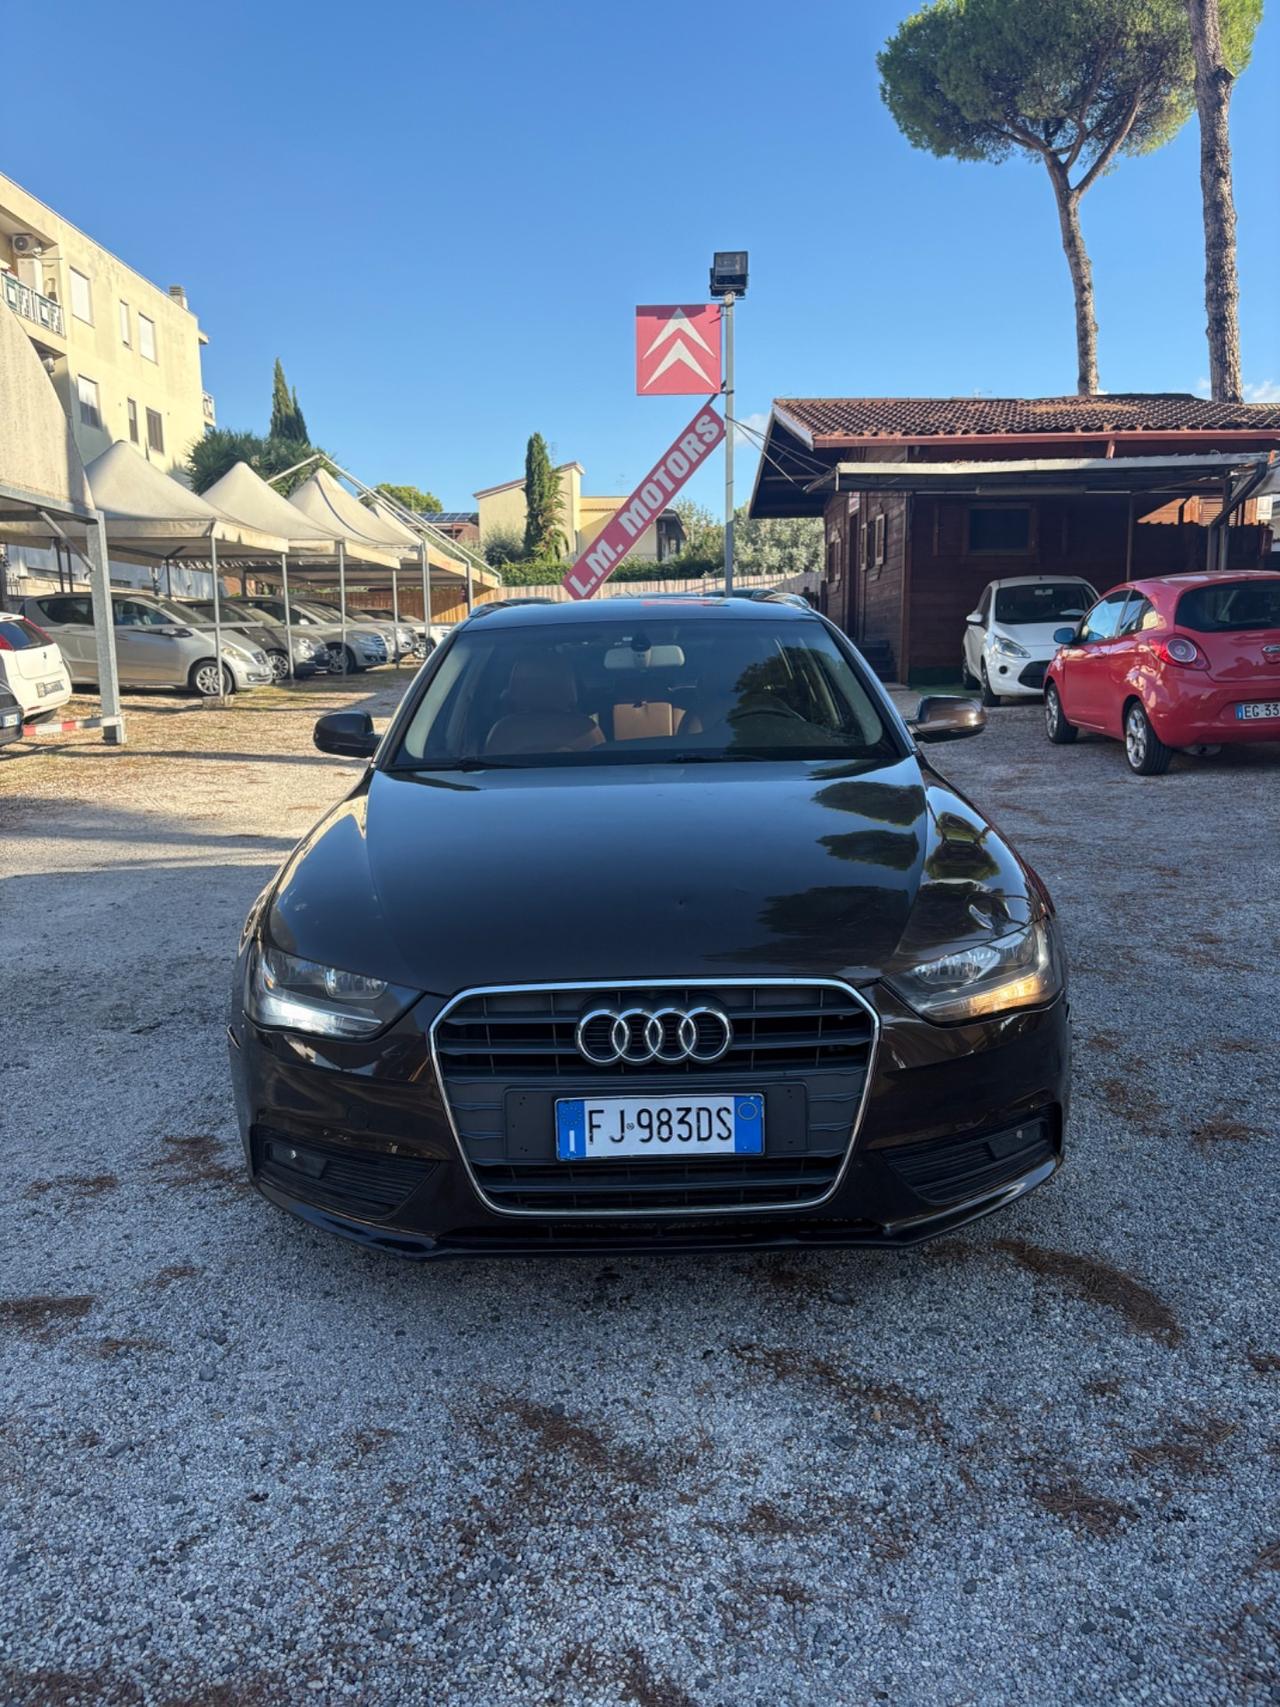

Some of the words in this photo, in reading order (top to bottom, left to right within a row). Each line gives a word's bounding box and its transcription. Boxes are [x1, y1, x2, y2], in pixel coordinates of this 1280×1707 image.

[569, 540, 625, 597] L.M.
[618, 414, 720, 537] MOTORS
[1244, 704, 1260, 718] EG
